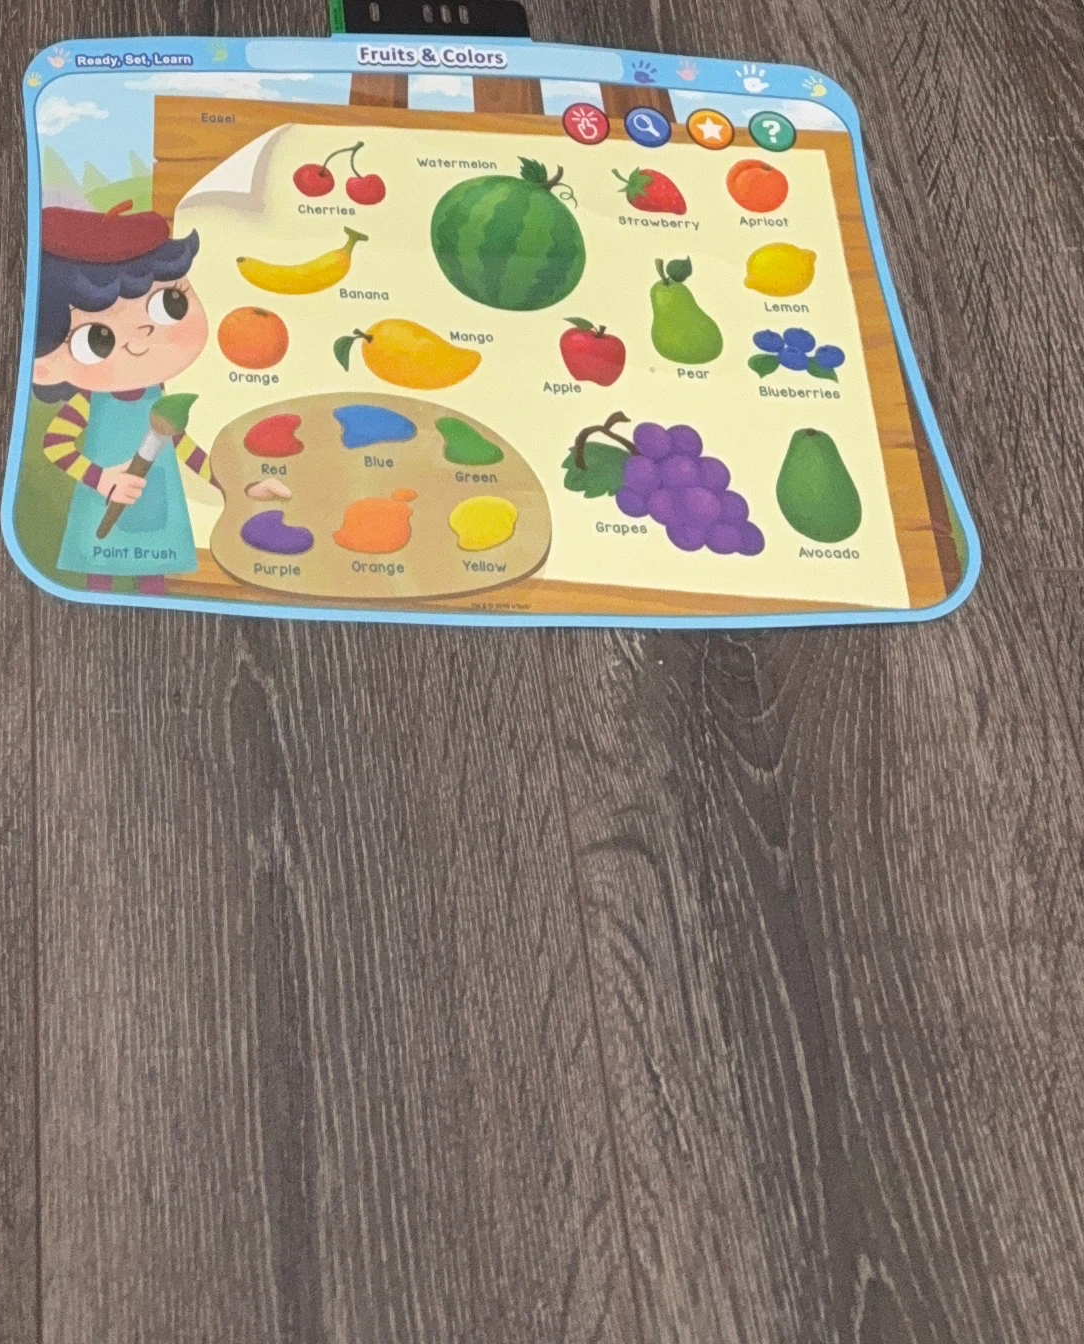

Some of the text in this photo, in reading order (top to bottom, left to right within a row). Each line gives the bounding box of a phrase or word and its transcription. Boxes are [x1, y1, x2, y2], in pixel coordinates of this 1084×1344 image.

[76, 52, 192, 68] Ready, Set, Learn
[358, 46, 505, 66] Fruits & Colors
[201, 112, 236, 125] Easel
[416, 157, 498, 171] Watermelon
[298, 204, 356, 216] Cherries
[618, 215, 700, 231] Strawberry
[739, 215, 789, 229] Apricot
[339, 288, 390, 301] Banana
[764, 302, 810, 314] Lemon
[450, 330, 494, 345] Mango
[228, 372, 280, 386] Orange
[677, 368, 710, 381] Pear
[543, 381, 582, 395] Apple
[758, 386, 840, 400] Blueberries
[364, 456, 394, 469] Blue
[260, 464, 287, 476] Red
[455, 472, 498, 484] Green
[596, 522, 648, 537] Grapes
[93, 546, 177, 561] Paint Brush
[798, 546, 860, 560] Avocado
[254, 564, 301, 578] Purple
[352, 562, 405, 576] Orange
[462, 560, 508, 574] Yellow
